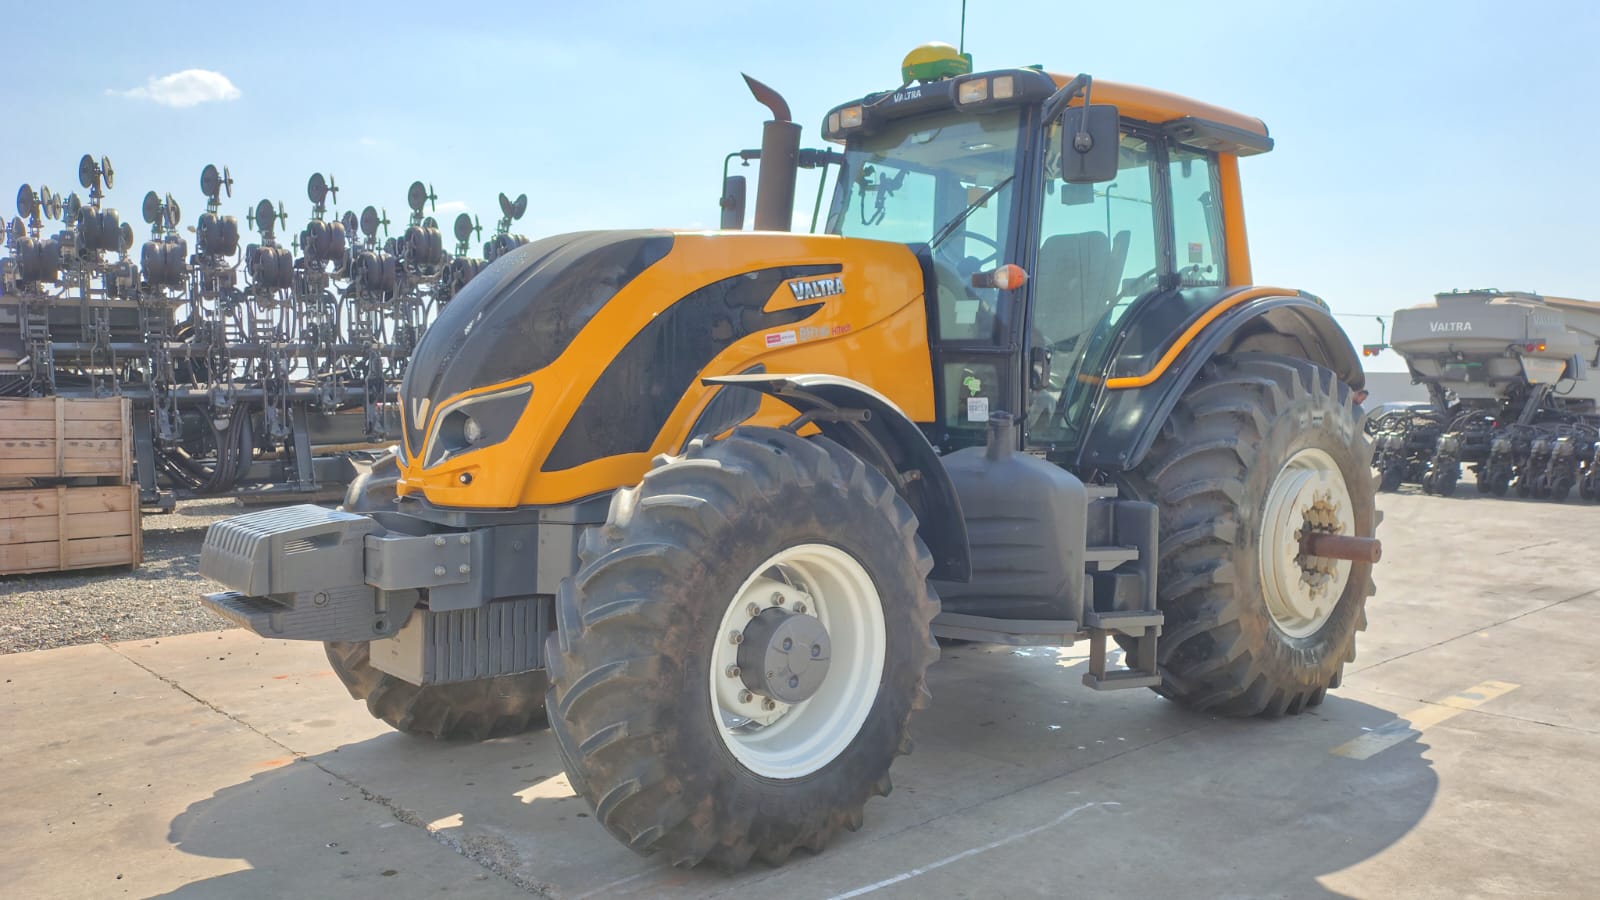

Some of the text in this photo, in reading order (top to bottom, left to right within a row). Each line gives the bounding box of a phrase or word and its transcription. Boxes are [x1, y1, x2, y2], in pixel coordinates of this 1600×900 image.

[893, 90, 922, 103] VALTRA
[788, 277, 845, 302] VALTRA
[1430, 321, 1473, 333] VALTRA
